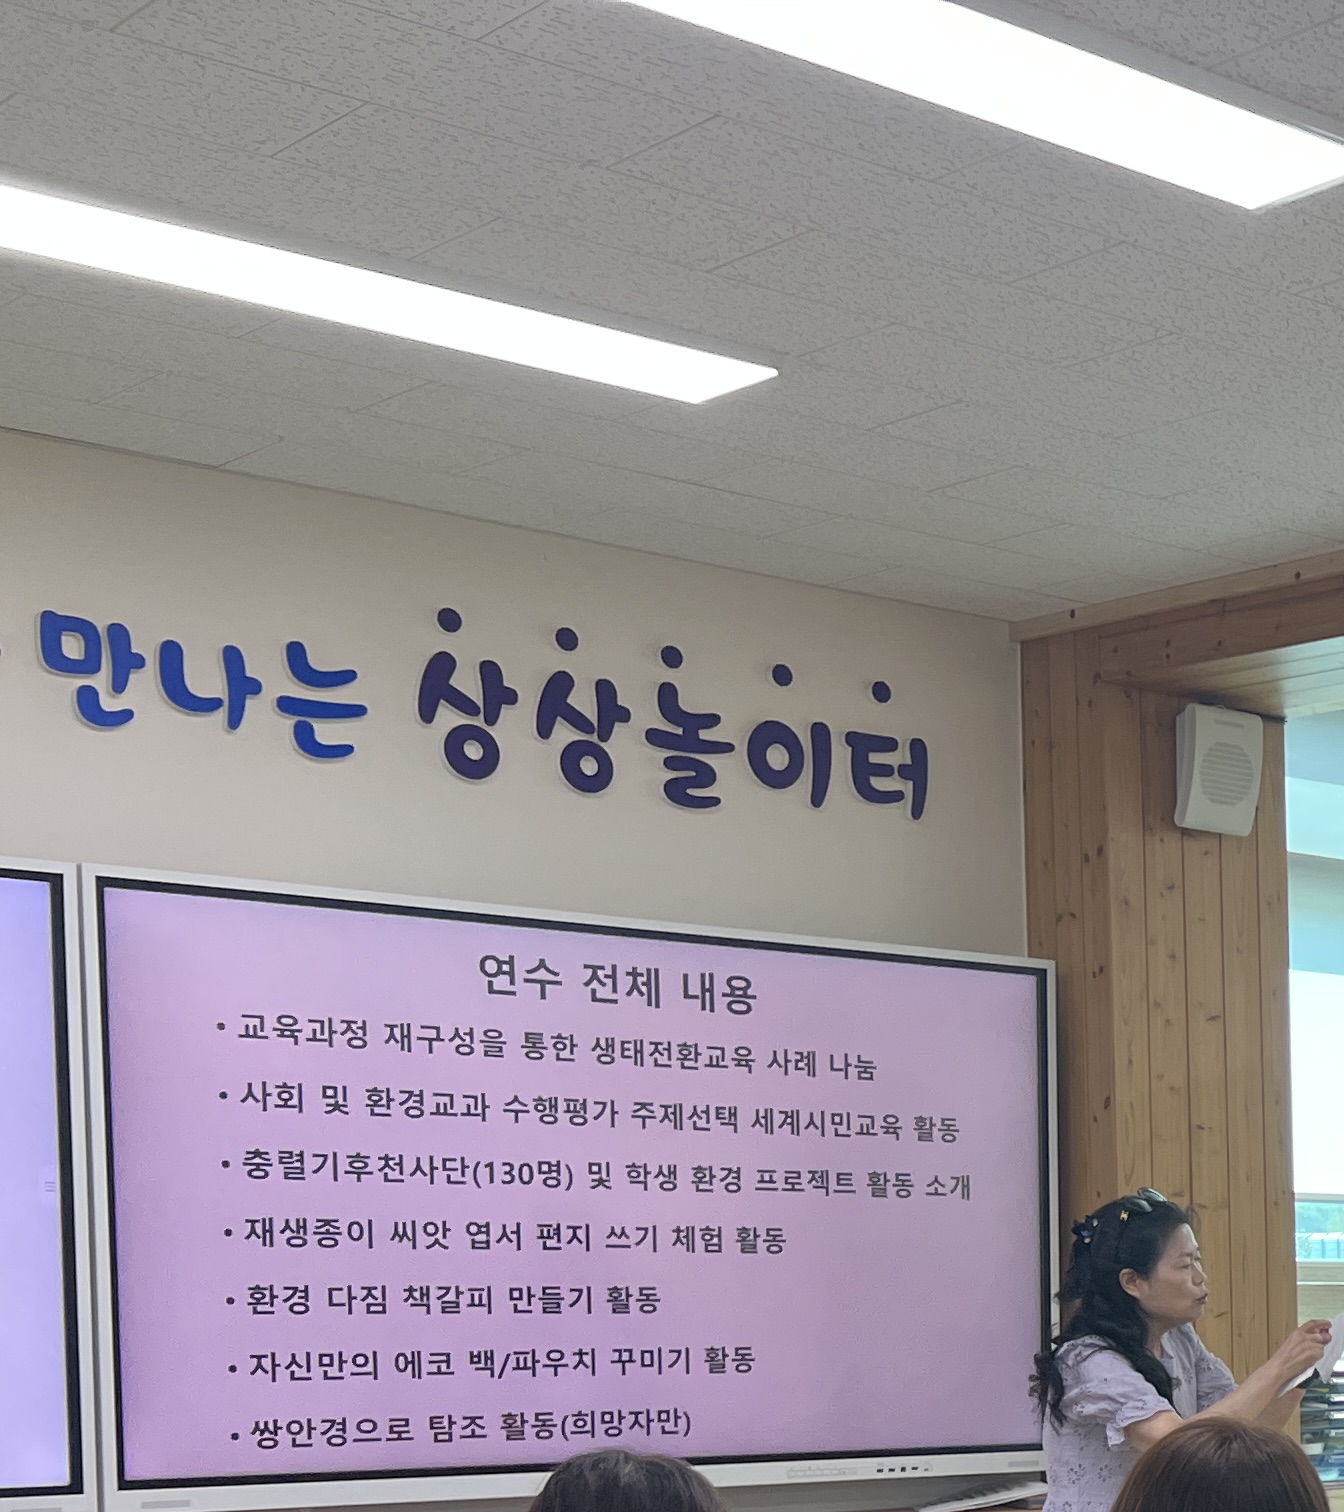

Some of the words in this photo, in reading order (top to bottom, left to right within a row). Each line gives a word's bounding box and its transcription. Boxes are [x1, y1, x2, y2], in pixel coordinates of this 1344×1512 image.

[38, 609, 369, 759] 만나는
[417, 607, 930, 821] 상상놀이터
[478, 953, 563, 1001] 연수
[581, 962, 661, 1010] 전체
[682, 971, 758, 1016] 내용
[236, 1013, 369, 1050] 교육과정
[383, 1022, 508, 1059] 재구성을
[519, 1031, 579, 1063] 통한
[589, 1036, 757, 1075] 생태전환교육
[766, 1048, 817, 1079] 사례
[829, 1052, 878, 1082] 나눔
[239, 1080, 304, 1115] 사회
[320, 1083, 352, 1116] 및
[363, 1086, 492, 1123] 환경교과
[501, 1094, 620, 1129] 수행평가
[630, 1101, 739, 1135] 주제선택
[750, 1107, 904, 1142] 세계시민교육
[912, 1115, 961, 1144] 활동
[241, 1147, 574, 1192] 충렬기후천사단(130명)
[587, 1160, 613, 1191] 및
[624, 1161, 678, 1193] 학생
[689, 1164, 743, 1195] 환경
[754, 1168, 857, 1198] 프로젝트
[866, 1170, 915, 1200] 활동
[924, 1174, 971, 1201] 소개
[243, 1216, 374, 1251] 재생종이
[389, 1218, 452, 1251] 씨앗
[464, 1220, 522, 1252] 엽서
[535, 1219, 591, 1253] 편지
[604, 1224, 658, 1254] 쓰기
[671, 1224, 723, 1254] 체험
[733, 1225, 788, 1256] 활동
[245, 1283, 316, 1317] 환경
[326, 1284, 388, 1316] 다짐
[400, 1283, 493, 1317] 책갈피
[508, 1285, 593, 1315] 만들기
[605, 1285, 662, 1315] 활동
[248, 1349, 379, 1384] 자신만의
[391, 1349, 456, 1381] 에코
[468, 1347, 597, 1380] 백/파우치
[609, 1346, 691, 1377] 꾸미기
[703, 1345, 757, 1375] 활동
[248, 1416, 415, 1451] 쌍안경으로
[428, 1413, 488, 1444] 탐조
[499, 1406, 692, 1443] 활동(희망자만)
